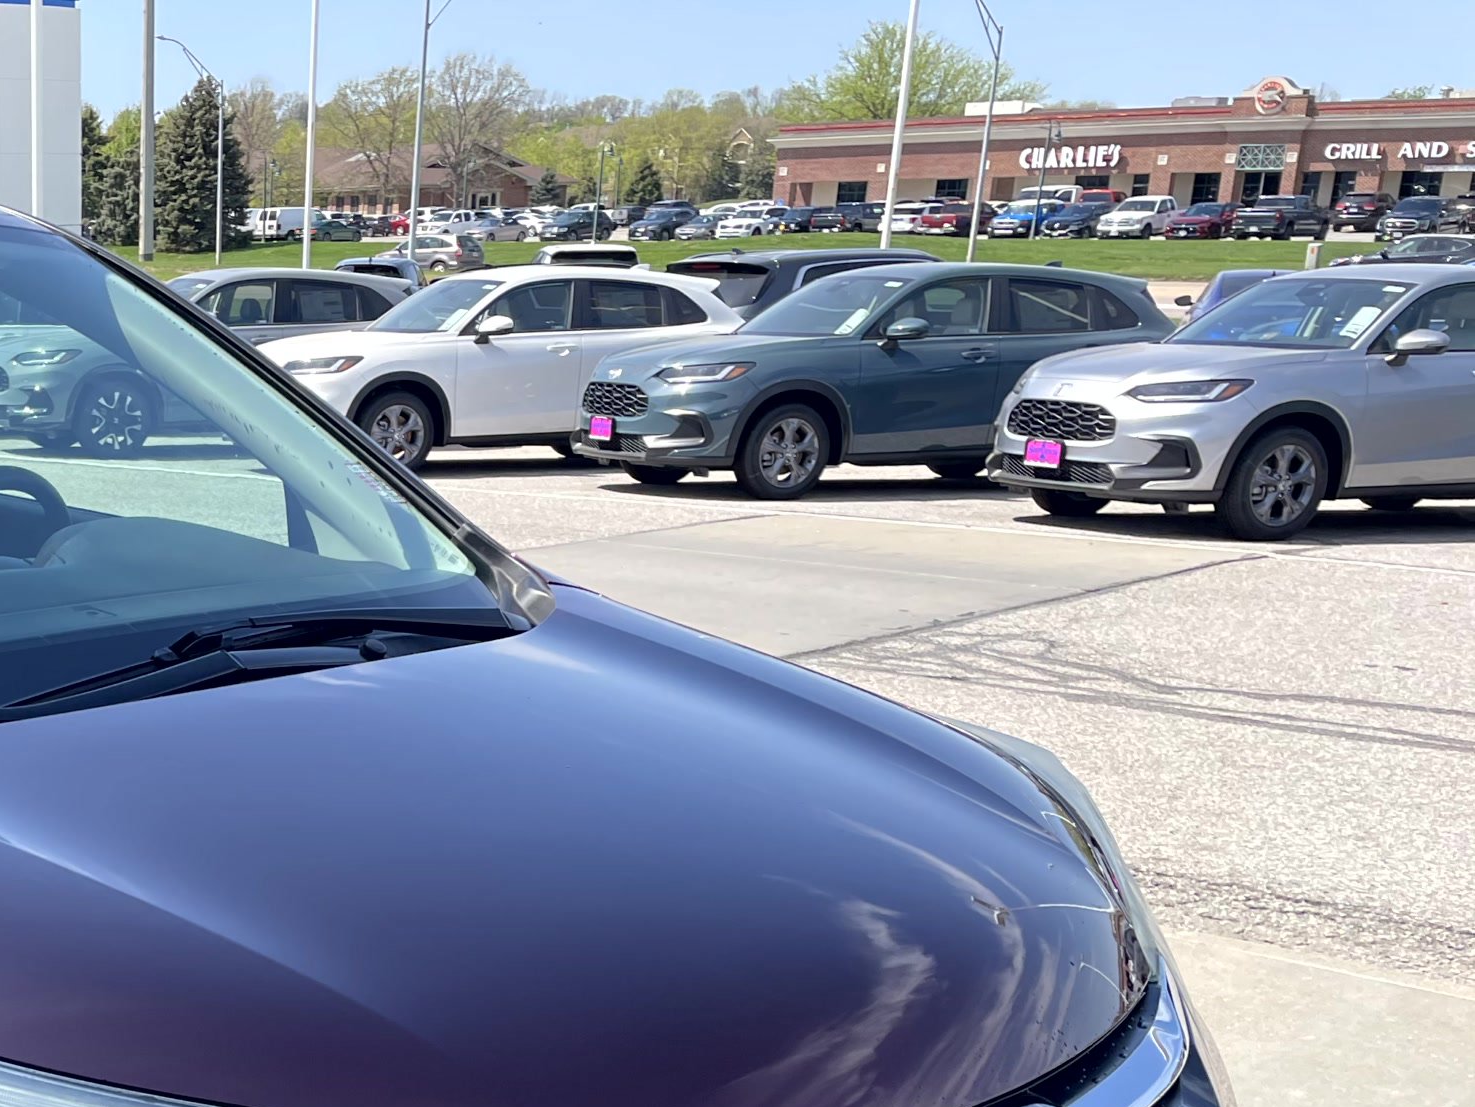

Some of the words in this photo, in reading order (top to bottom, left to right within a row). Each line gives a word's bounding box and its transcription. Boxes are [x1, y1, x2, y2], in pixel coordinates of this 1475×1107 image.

[1019, 144, 1122, 169] CHARLIE'S
[1325, 142, 1382, 160] GRILL
[1397, 141, 1449, 159] AND
